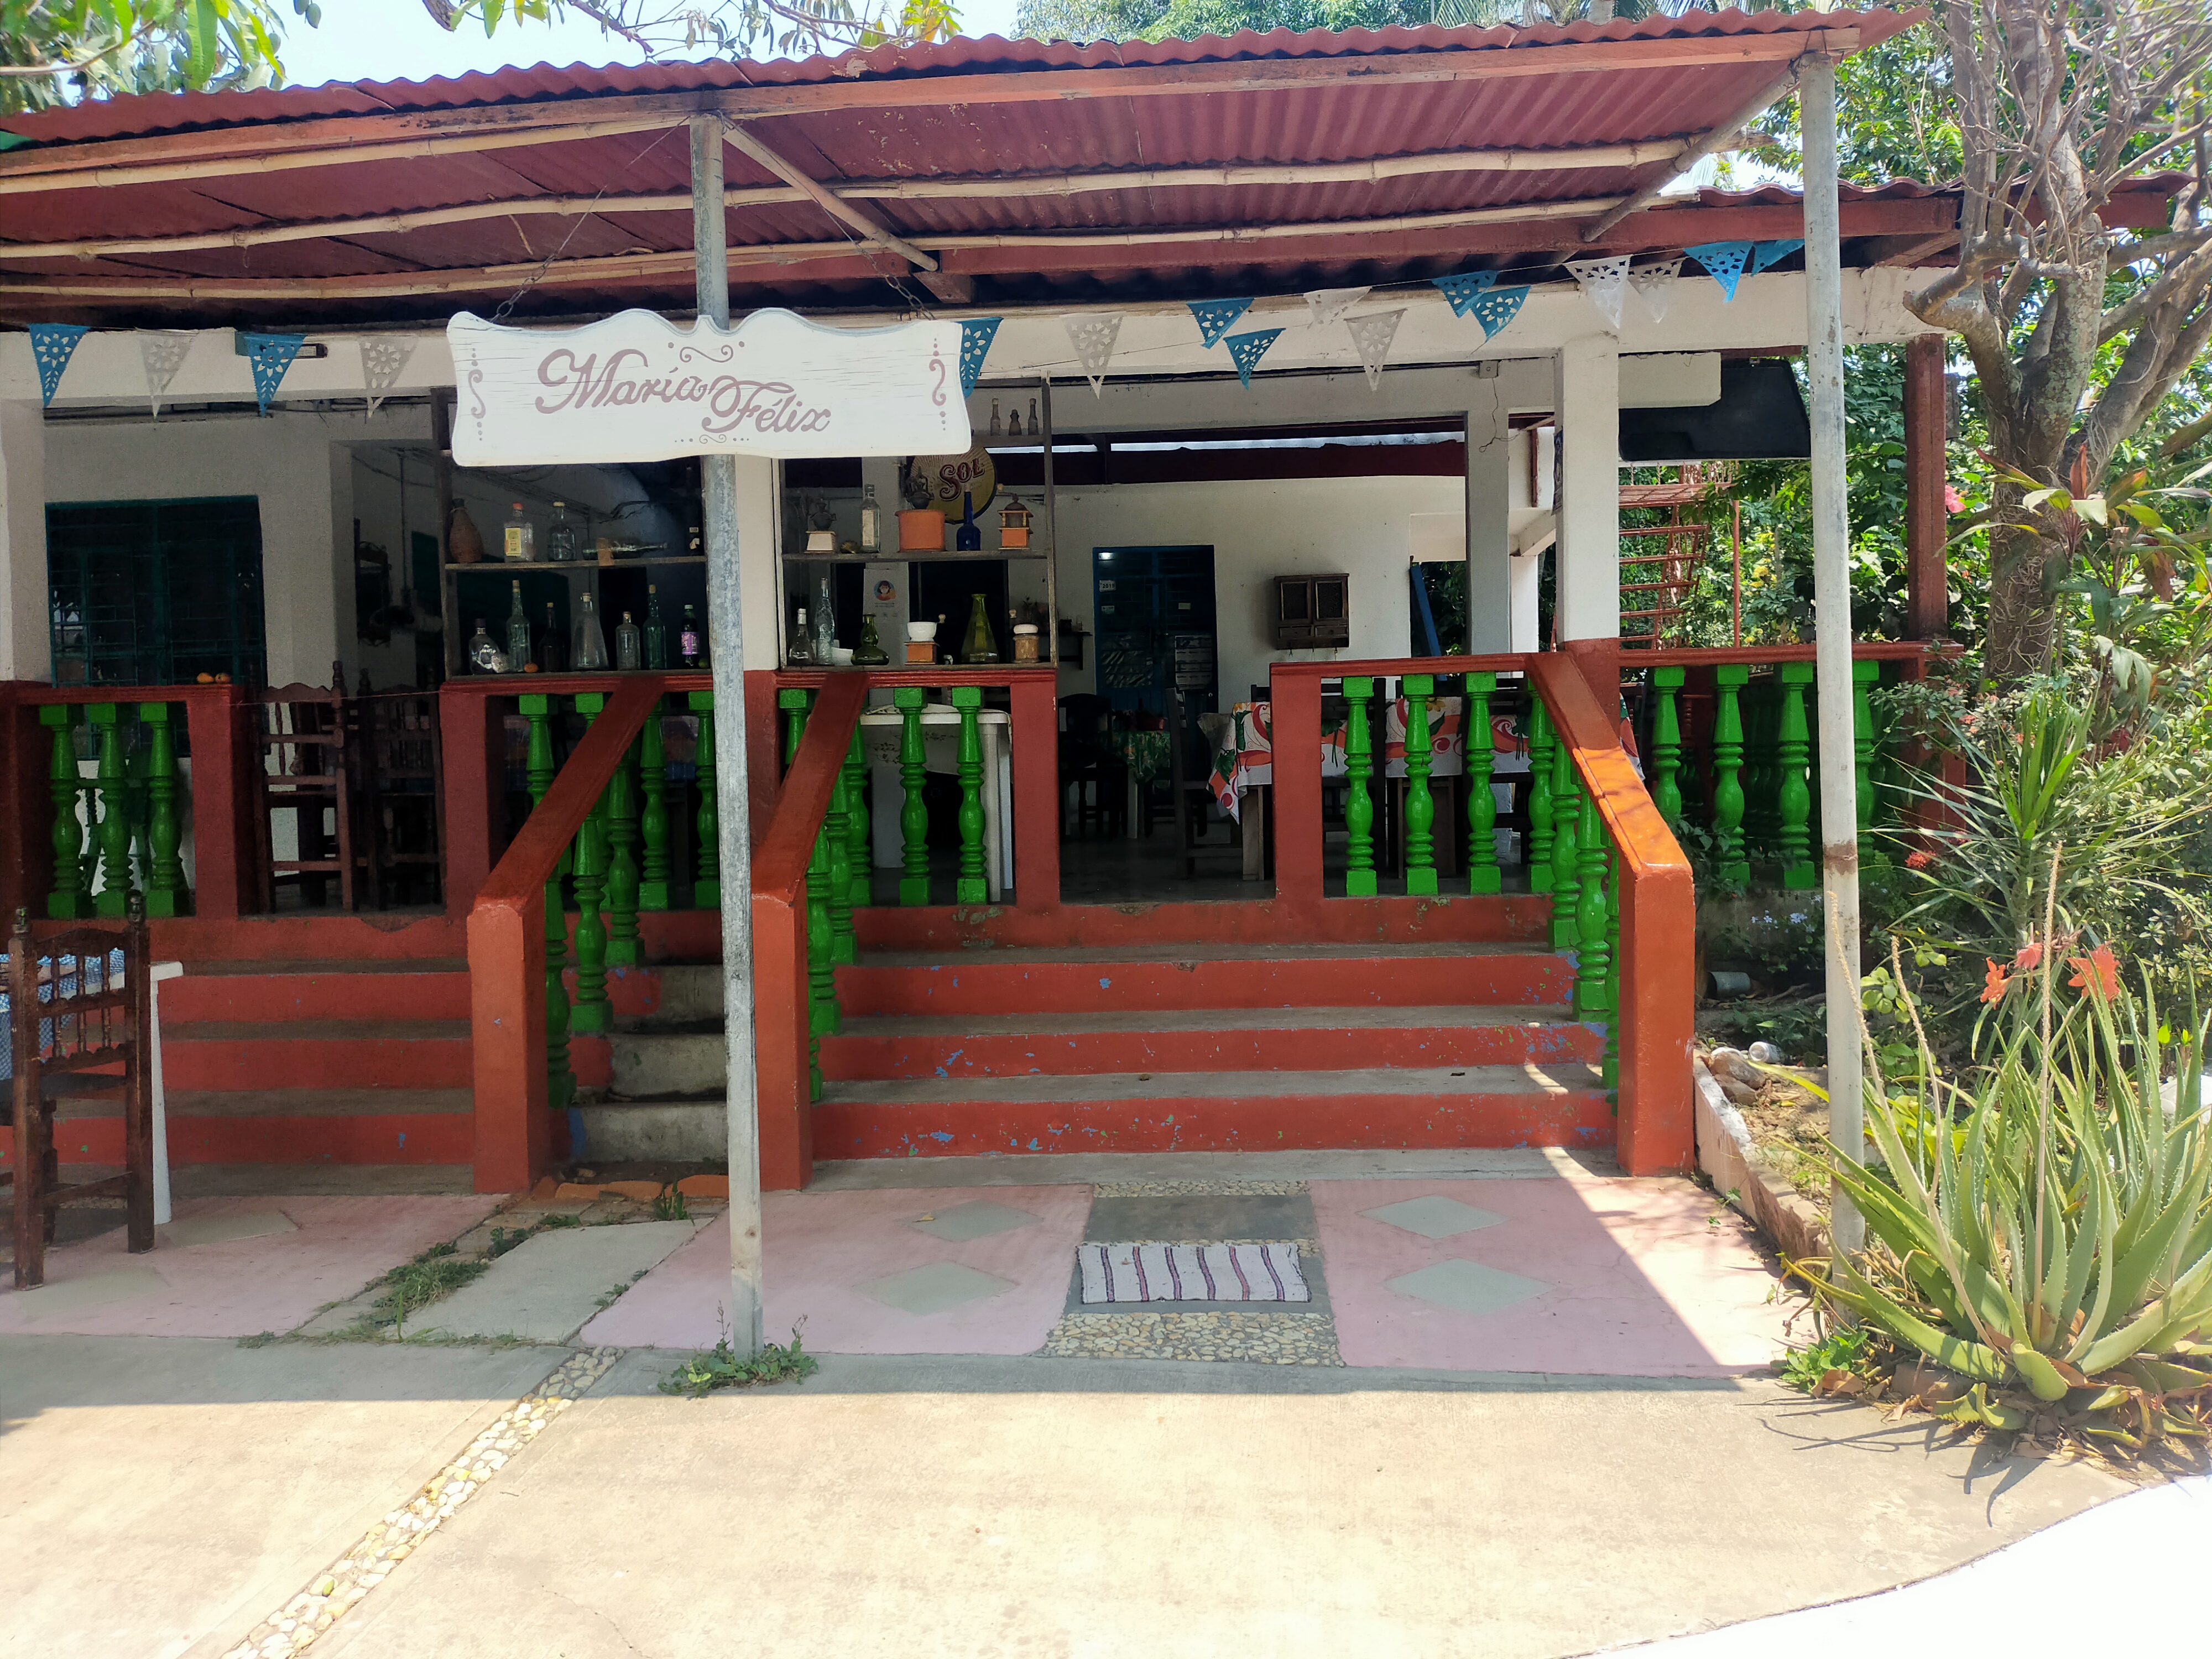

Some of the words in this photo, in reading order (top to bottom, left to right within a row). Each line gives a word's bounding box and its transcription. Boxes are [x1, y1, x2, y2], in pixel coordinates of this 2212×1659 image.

[535, 348, 707, 414] María
[701, 375, 831, 433] Félix
[940, 458, 985, 501] SOL
